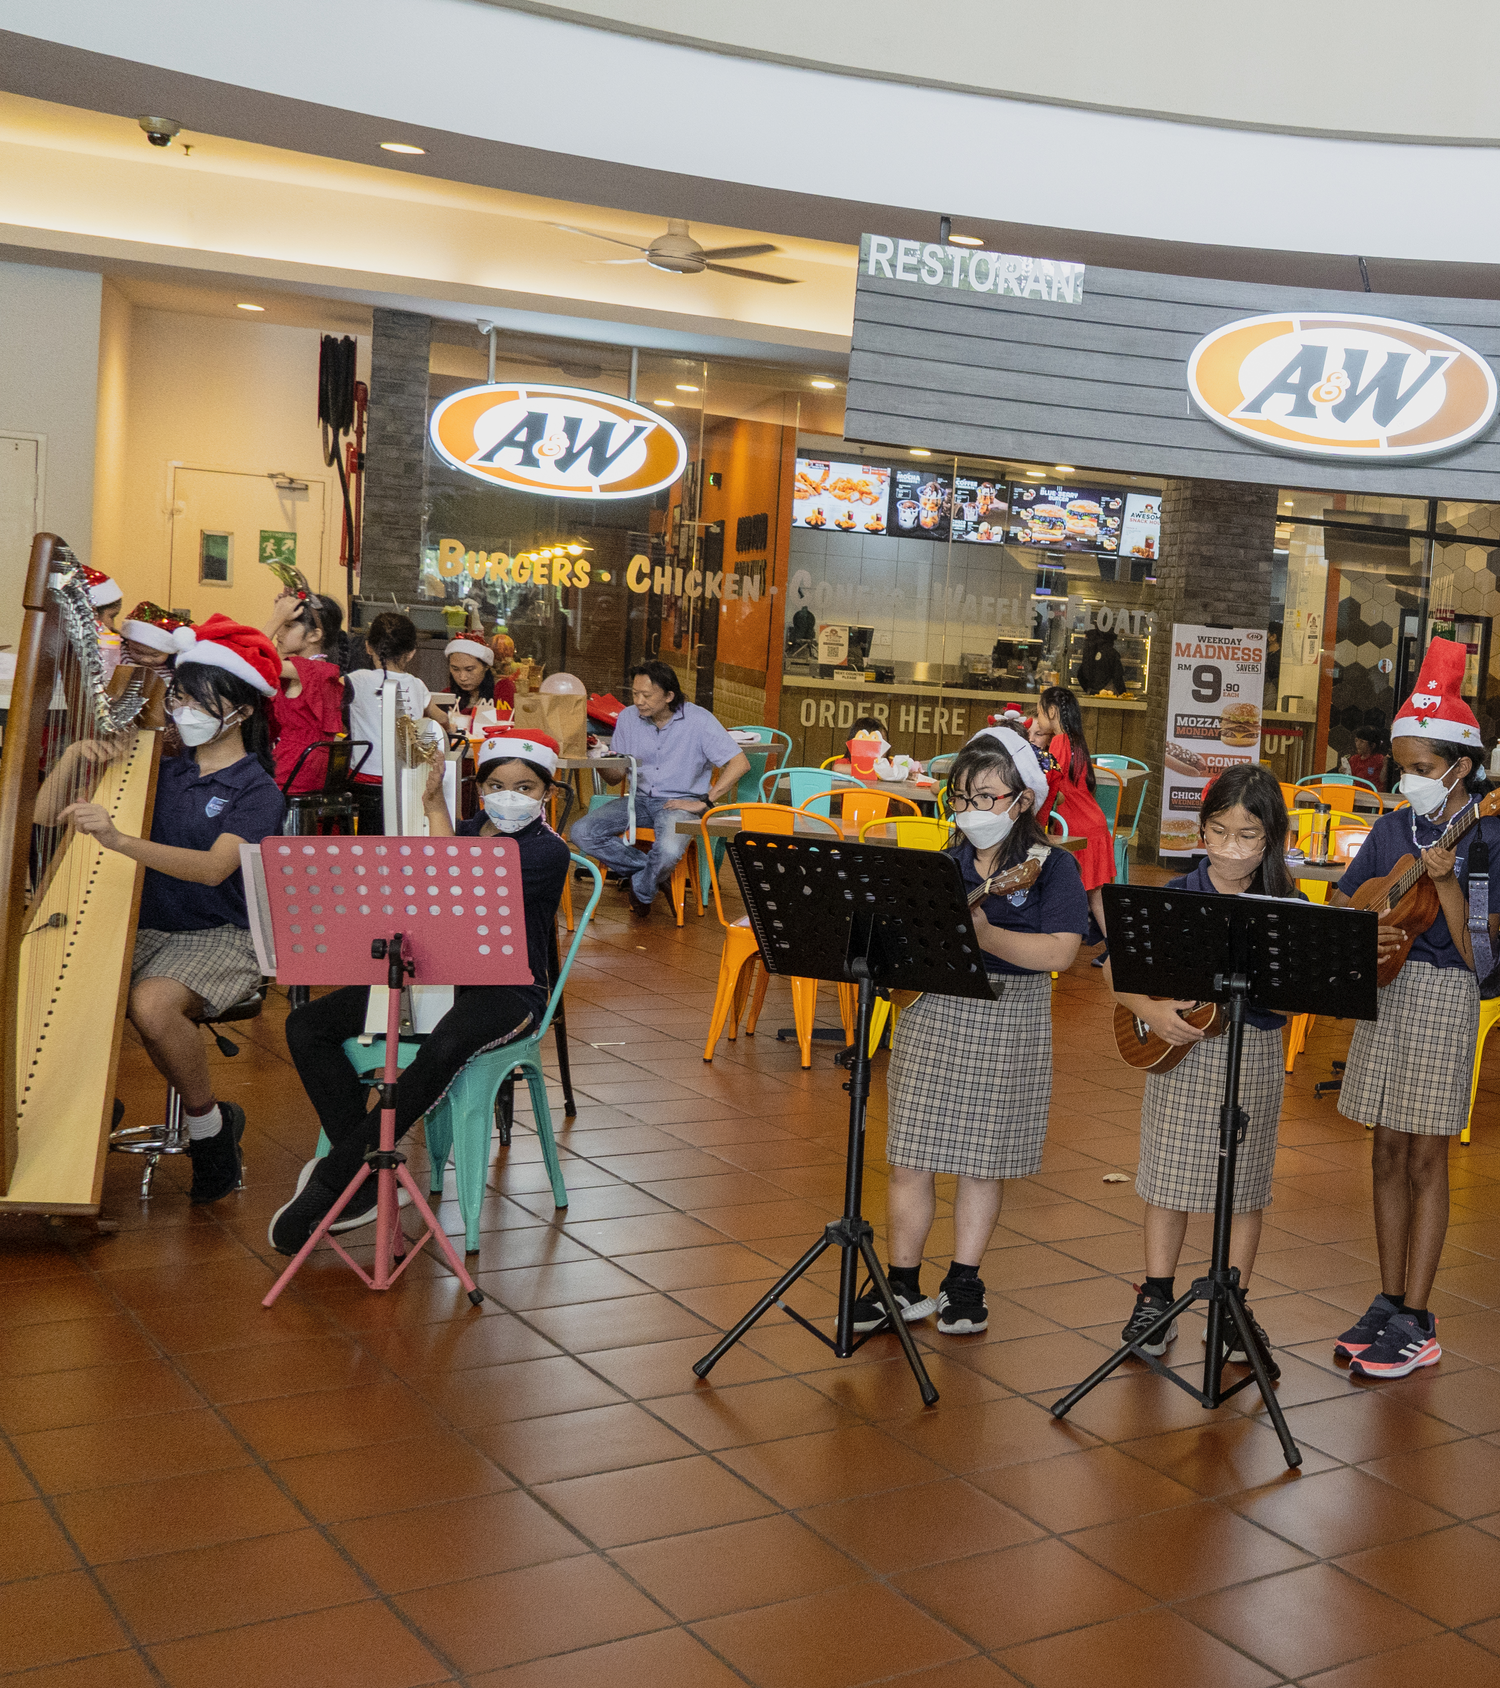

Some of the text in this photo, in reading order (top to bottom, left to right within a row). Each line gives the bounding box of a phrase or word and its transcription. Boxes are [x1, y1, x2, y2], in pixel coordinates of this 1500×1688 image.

[866, 234, 1077, 304] RESTORAN
[1240, 343, 1450, 428] A&W
[477, 410, 649, 478] A&W
[1197, 635, 1243, 646] WEEKDAY
[1174, 642, 1263, 662] MADNESS
[1236, 663, 1259, 673] SAVERS
[1177, 663, 1240, 704] RM 9 .90
[800, 698, 966, 736] ORDER HERE
[1176, 716, 1221, 728] MOZZA
[1175, 726, 1220, 737] MONDAY
[1264, 733, 1295, 755] UP
